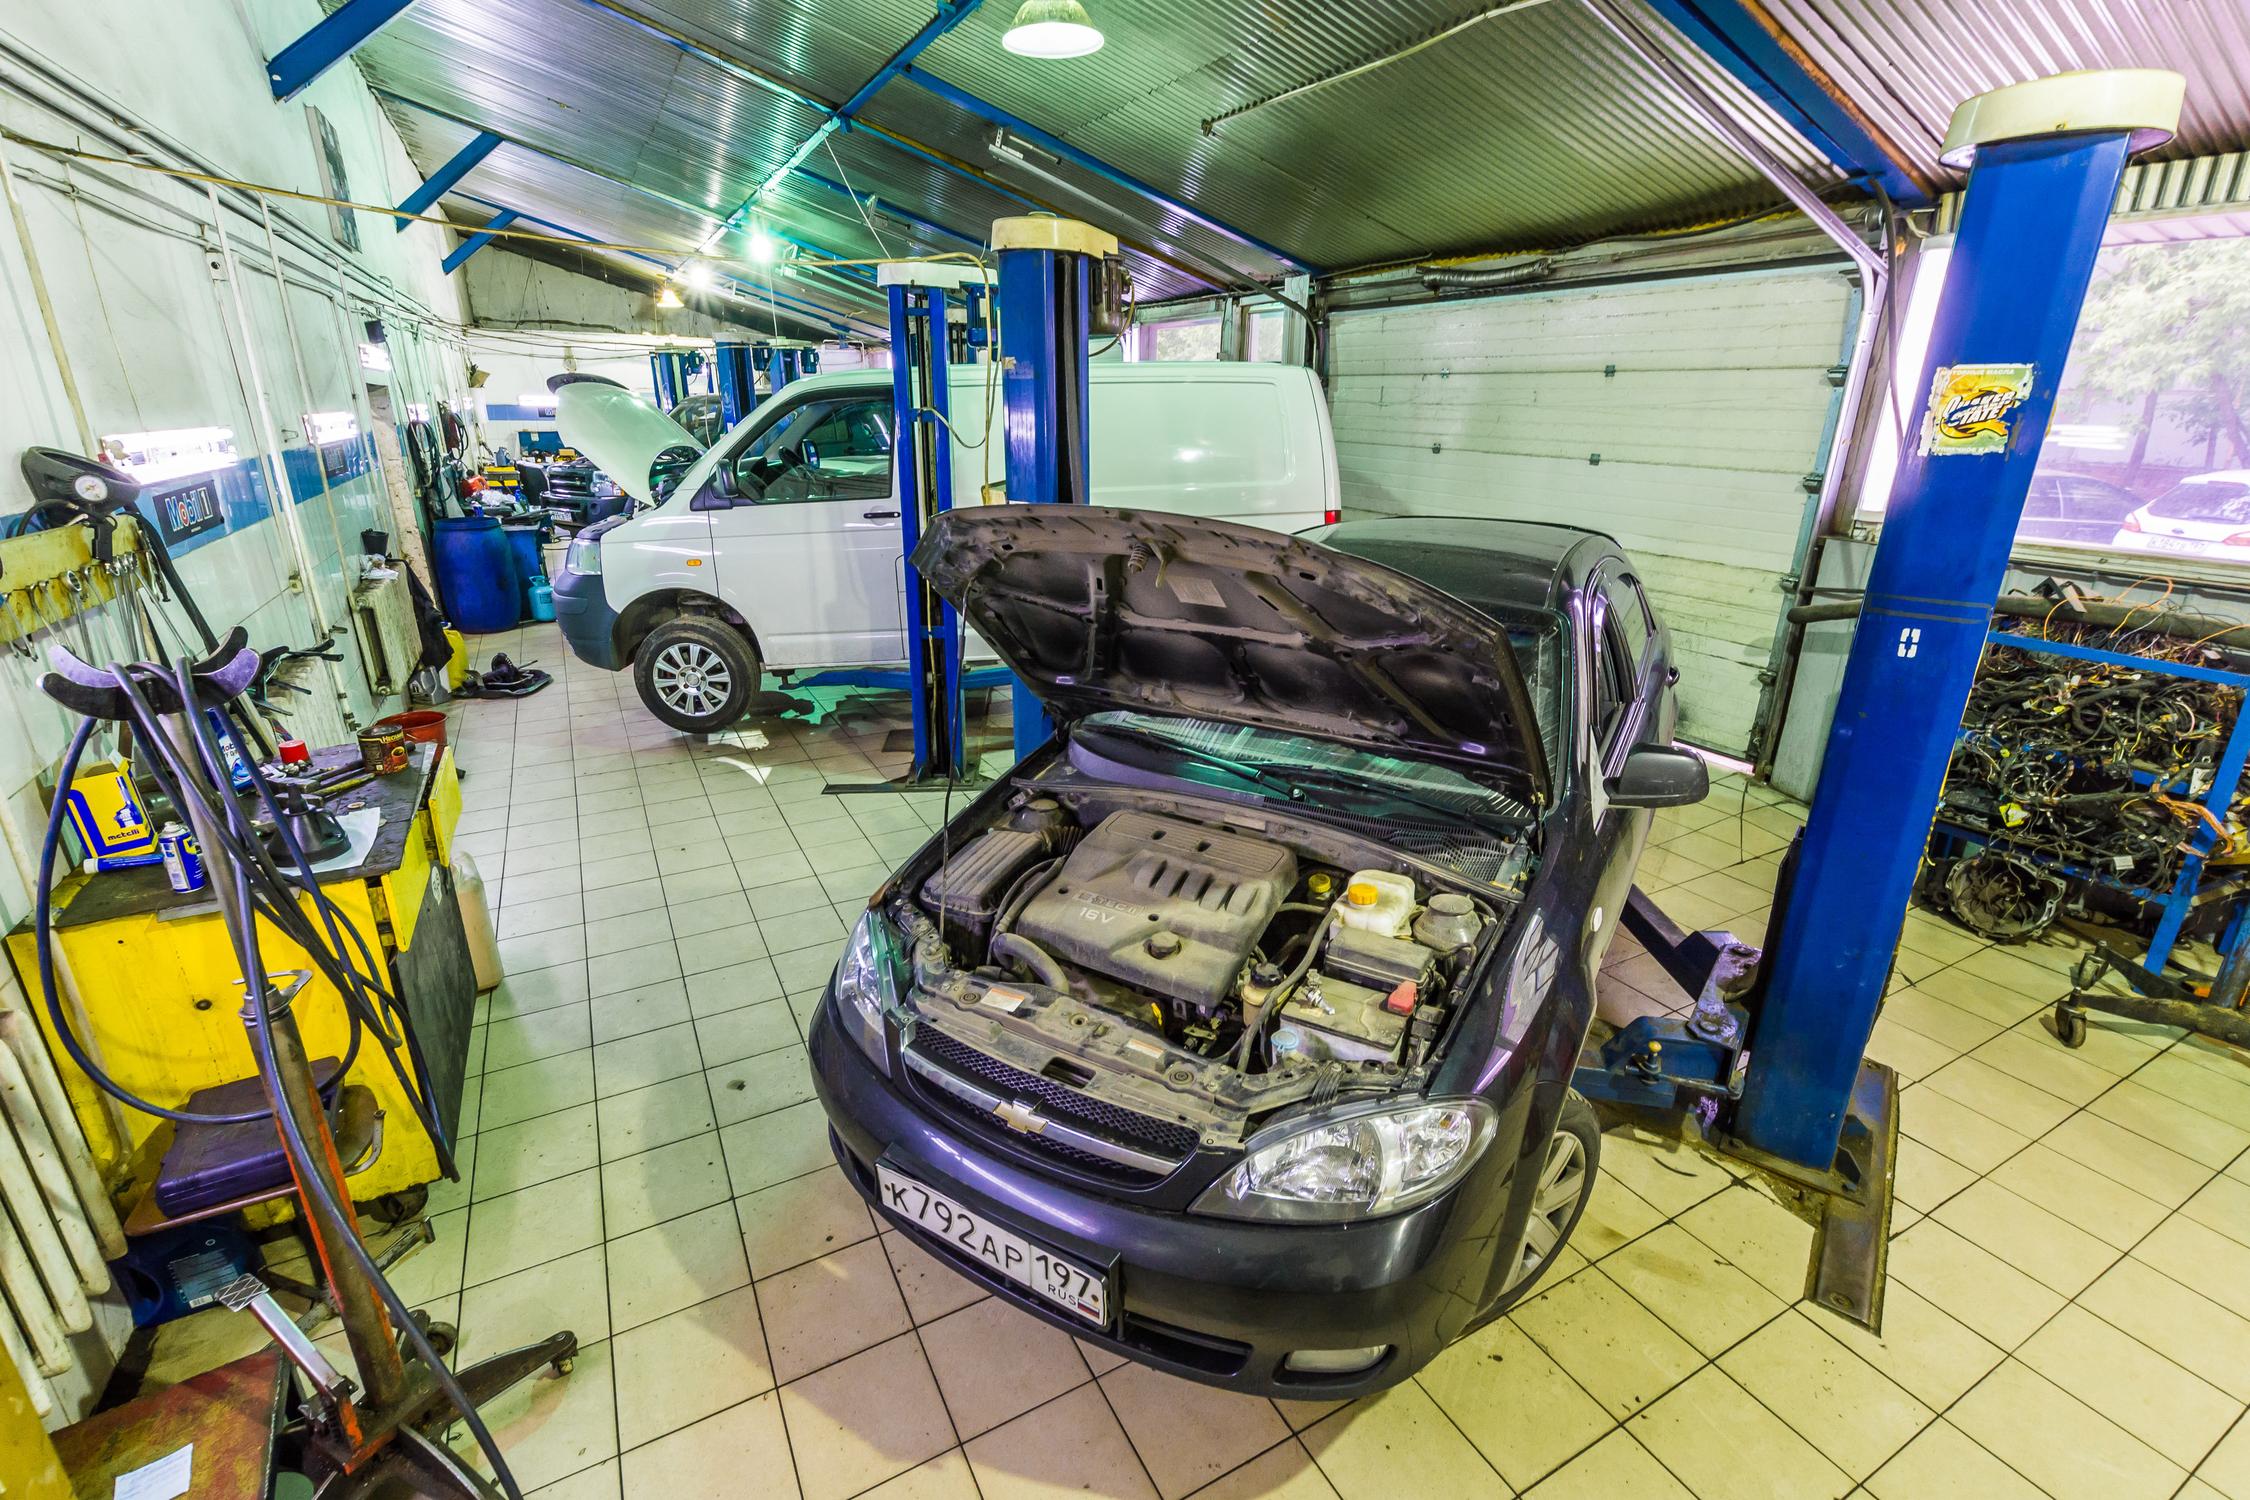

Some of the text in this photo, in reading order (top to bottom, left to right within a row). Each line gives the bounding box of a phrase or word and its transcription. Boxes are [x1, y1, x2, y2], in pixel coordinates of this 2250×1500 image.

[1947, 404, 2002, 427] STATE
[164, 489, 204, 532] Mobil
[107, 828, 140, 841] metelli
[1079, 906, 1116, 924] 16V
[1036, 1255, 1093, 1298] 197
[1048, 1283, 1078, 1306] RUS
